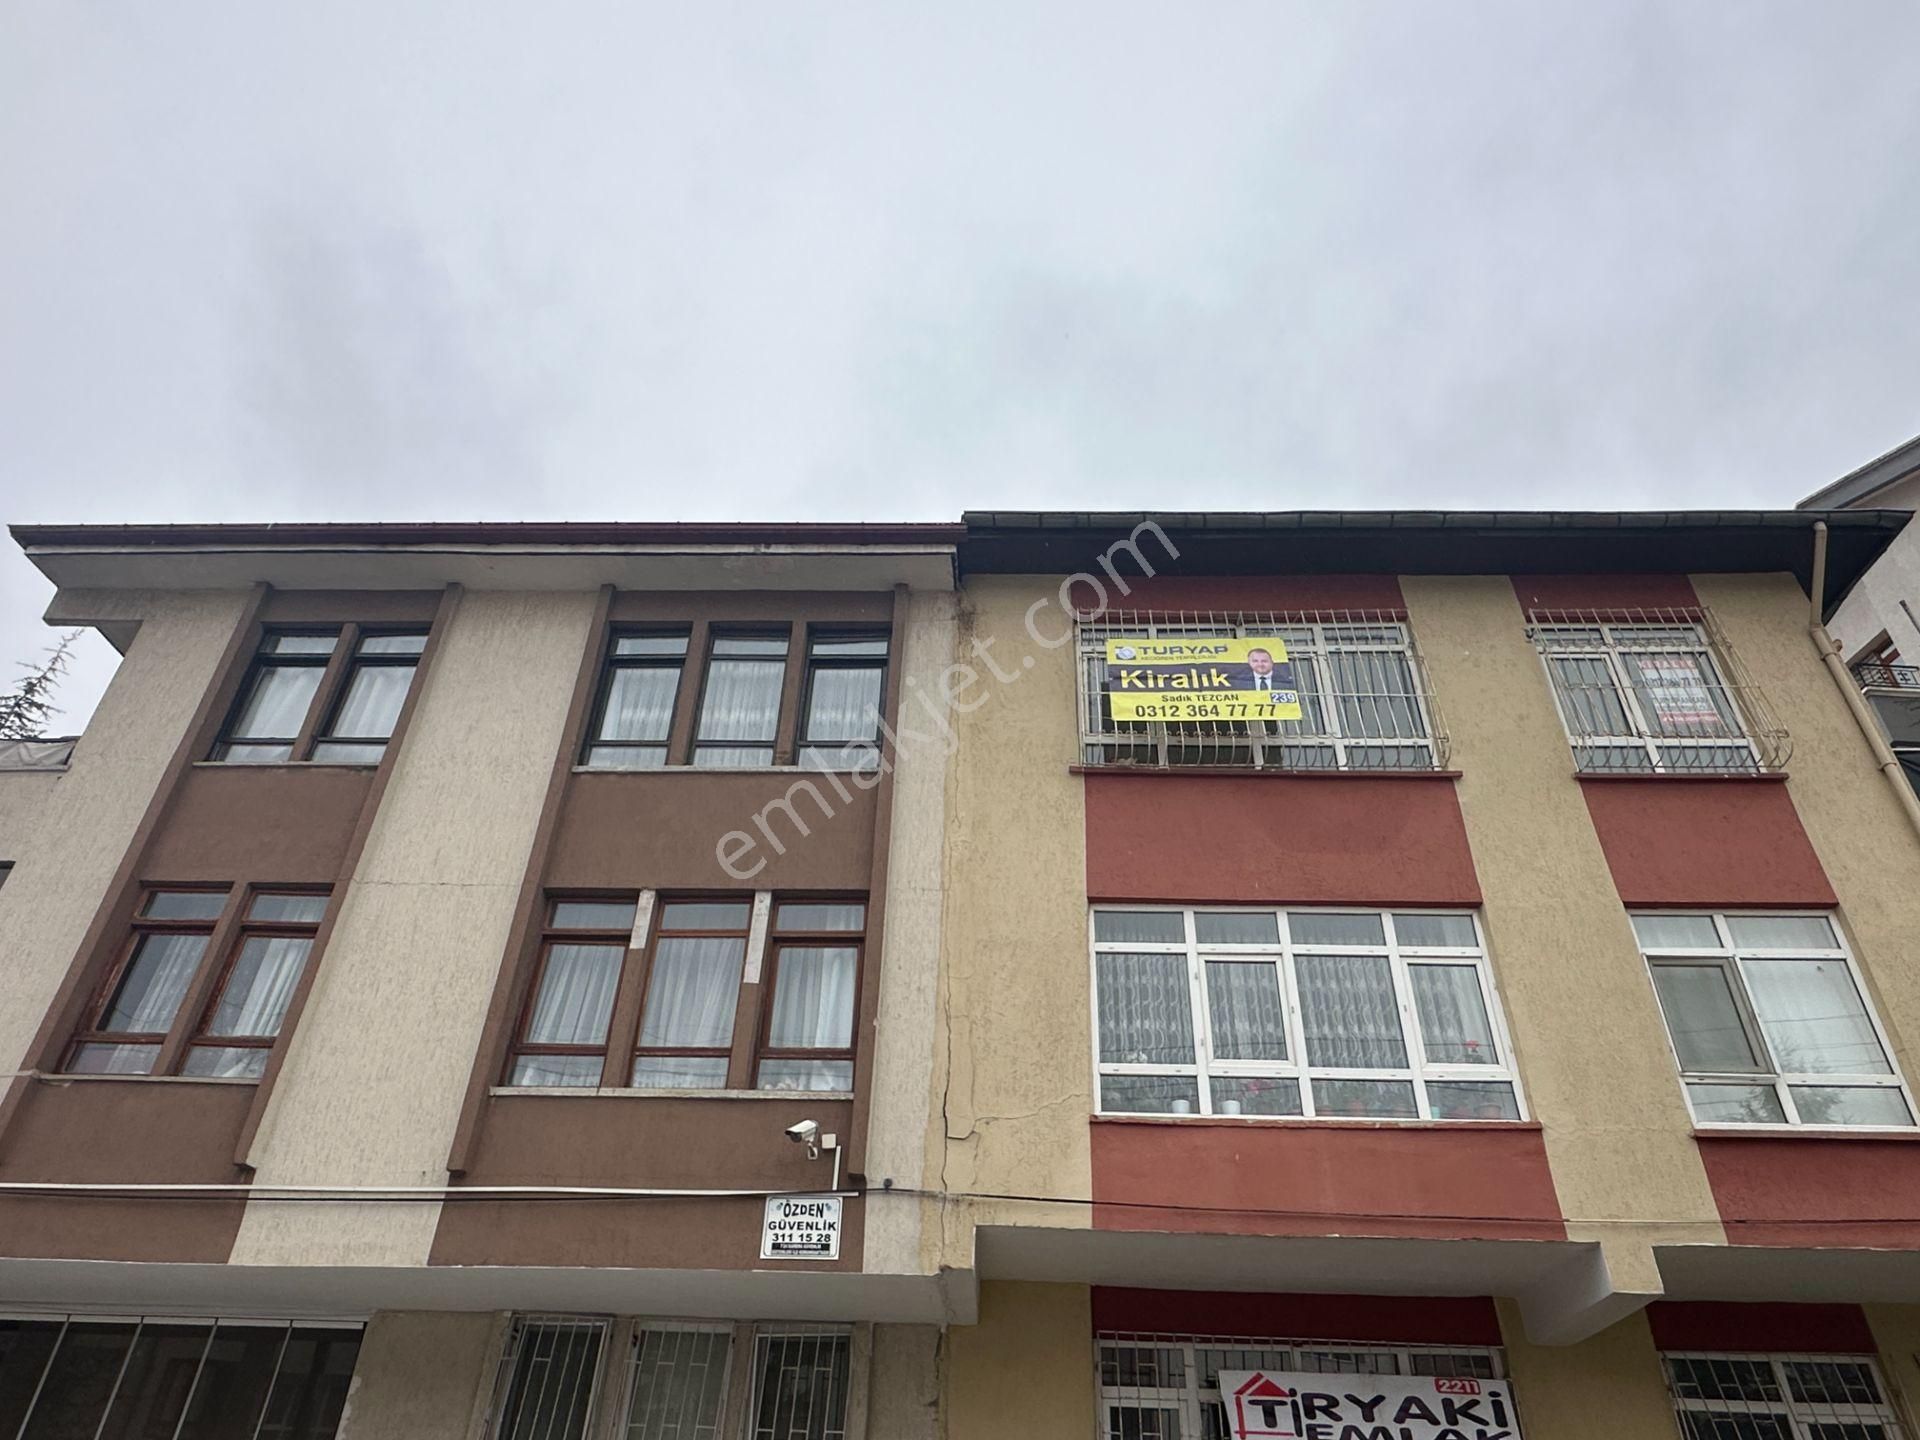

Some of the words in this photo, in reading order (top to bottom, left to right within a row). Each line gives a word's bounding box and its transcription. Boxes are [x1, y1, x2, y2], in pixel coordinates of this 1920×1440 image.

[1138, 646, 1228, 655] TURYAP
[1120, 668, 1231, 689] Kiralık
[1196, 694, 1239, 702] TEZCAN
[1271, 693, 1296, 704] 239
[1135, 705, 1180, 717] 0312
[1186, 704, 1219, 717] 364
[1225, 704, 1248, 716] 77
[1254, 704, 1276, 716] 77
[783, 1199, 824, 1218] ÖZDEN
[768, 1219, 836, 1231] GÜVENLİK
[772, 1233, 793, 1242] 311
[798, 1233, 813, 1242] 15
[816, 1233, 831, 1243] 28
[1438, 1380, 1479, 1393] 2211
